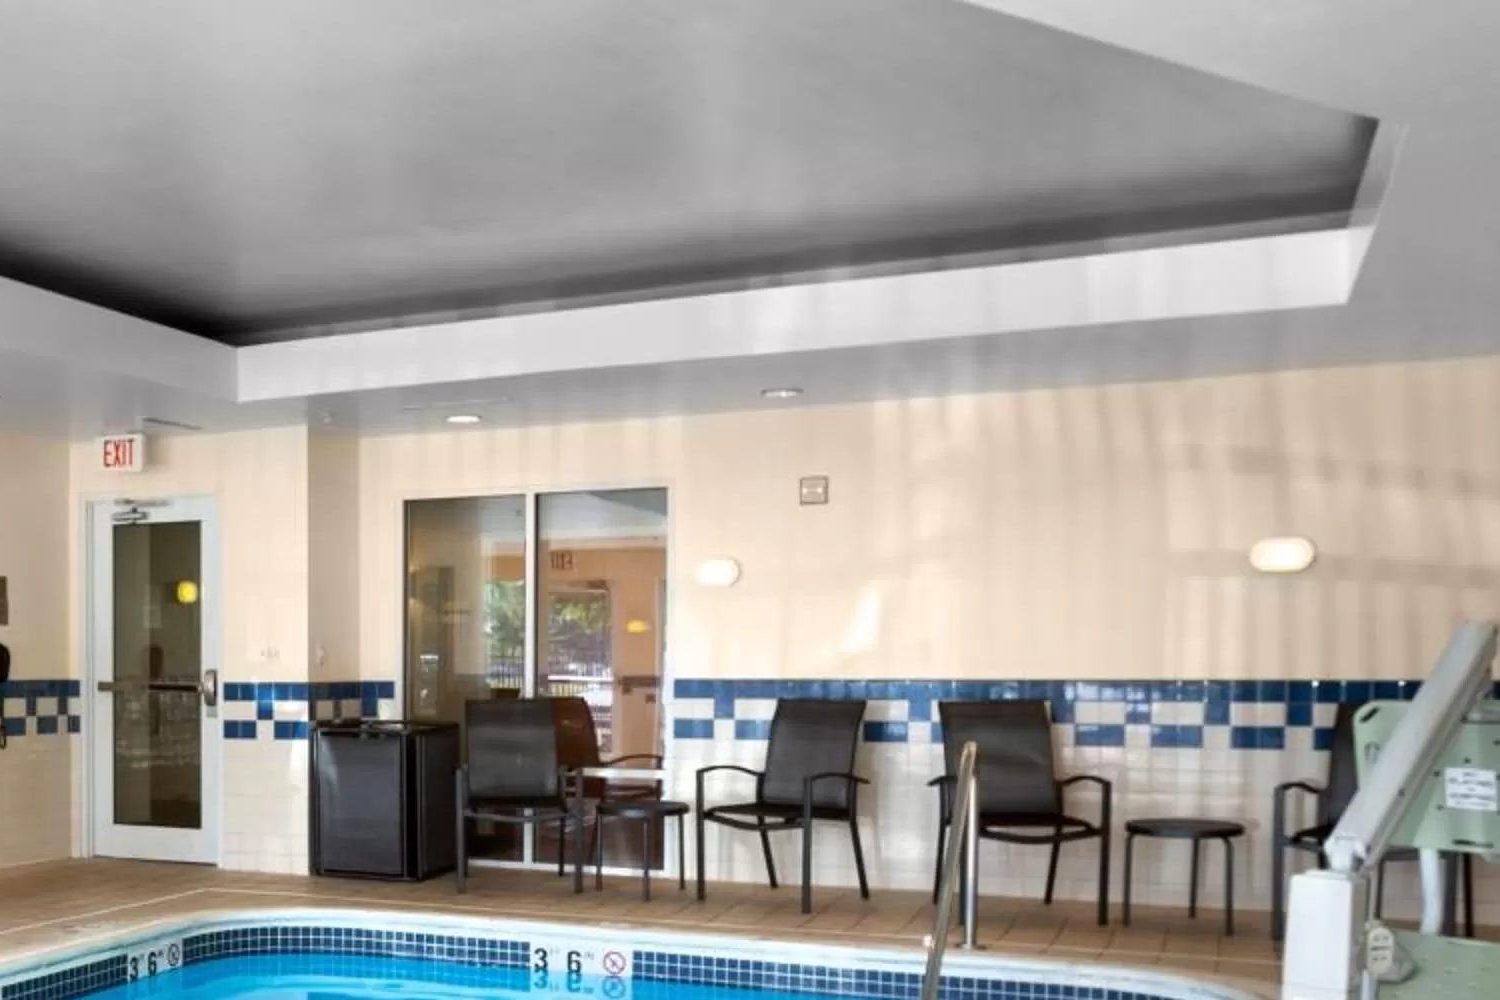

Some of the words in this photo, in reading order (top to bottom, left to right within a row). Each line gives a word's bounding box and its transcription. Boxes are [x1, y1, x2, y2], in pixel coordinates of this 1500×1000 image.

[103, 438, 134, 468] EXIT
[129, 955, 139, 981] 3
[148, 950, 157, 977] 6
[533, 947, 548, 972] 3
[567, 950, 581, 973] 6
